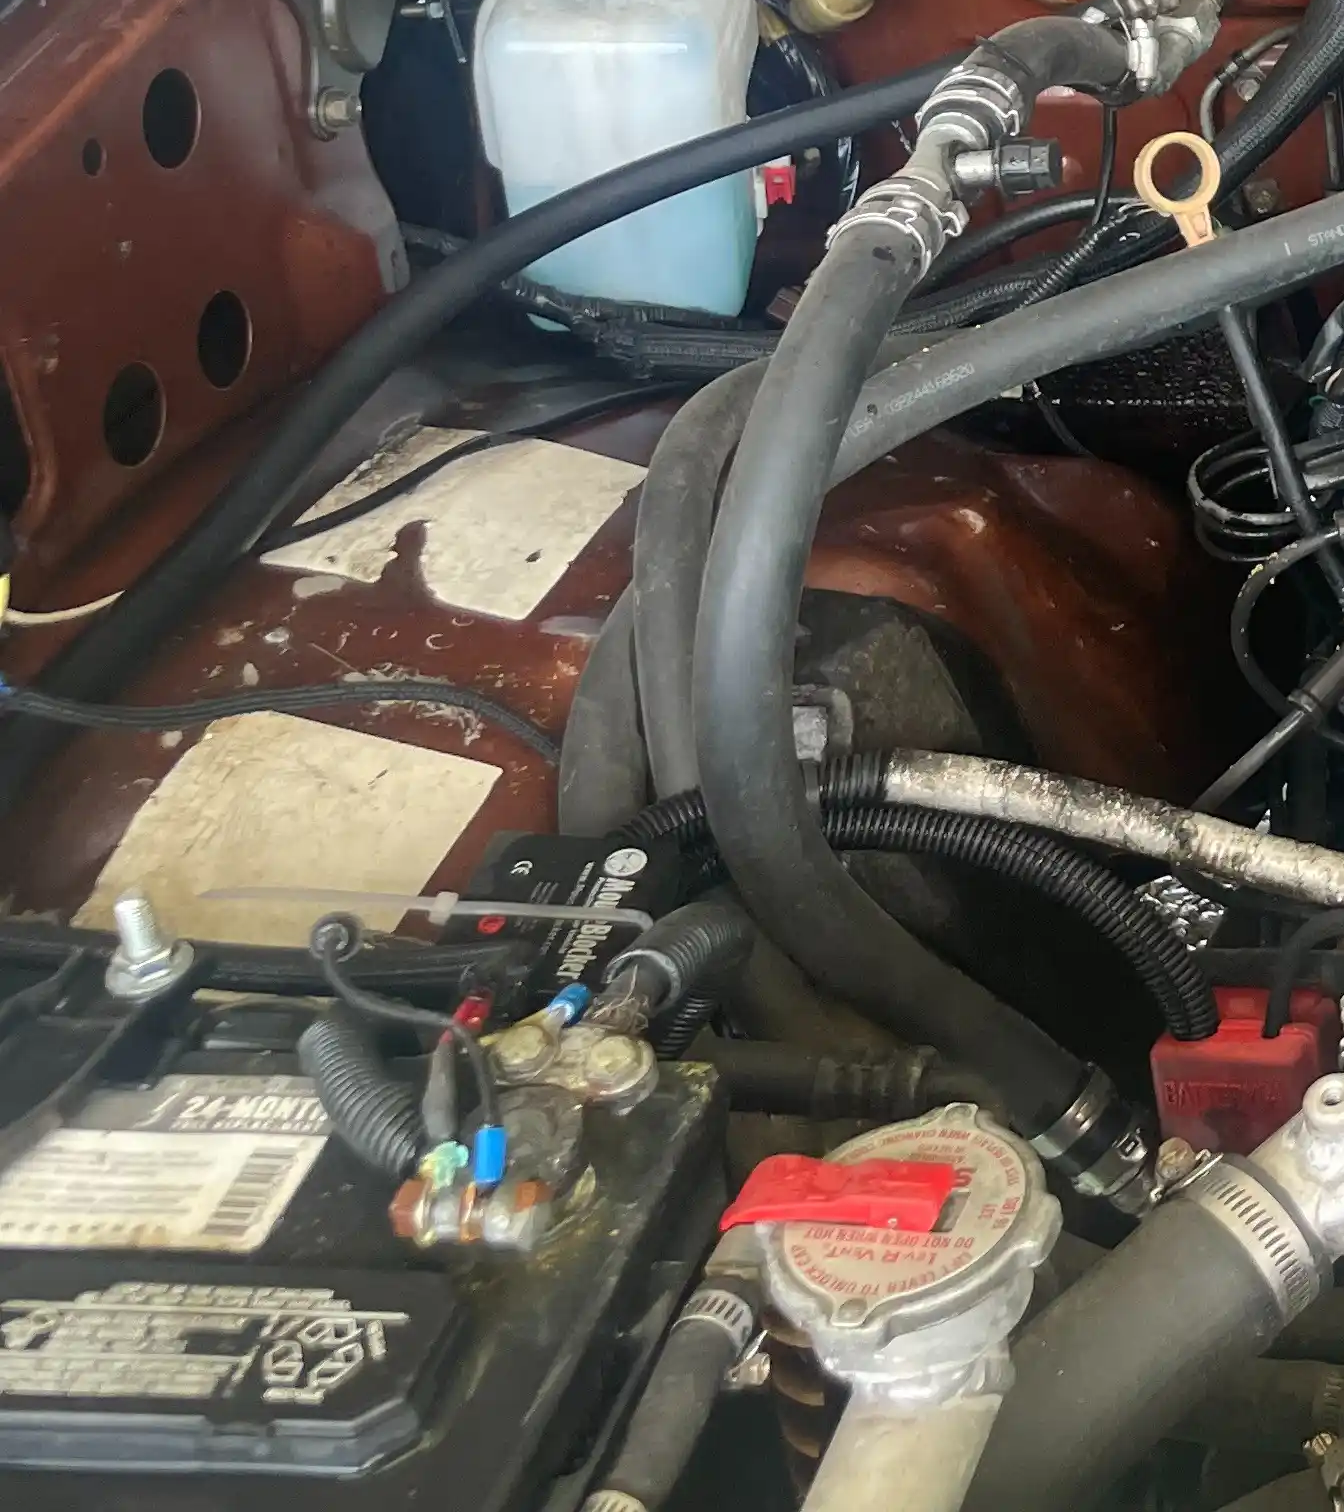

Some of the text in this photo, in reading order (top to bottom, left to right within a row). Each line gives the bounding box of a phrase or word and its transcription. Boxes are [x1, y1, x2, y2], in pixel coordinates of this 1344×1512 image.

[803, 1226, 975, 1249] DO NOT OPEN WHEN HOT
[861, 1283, 880, 1297] TO
